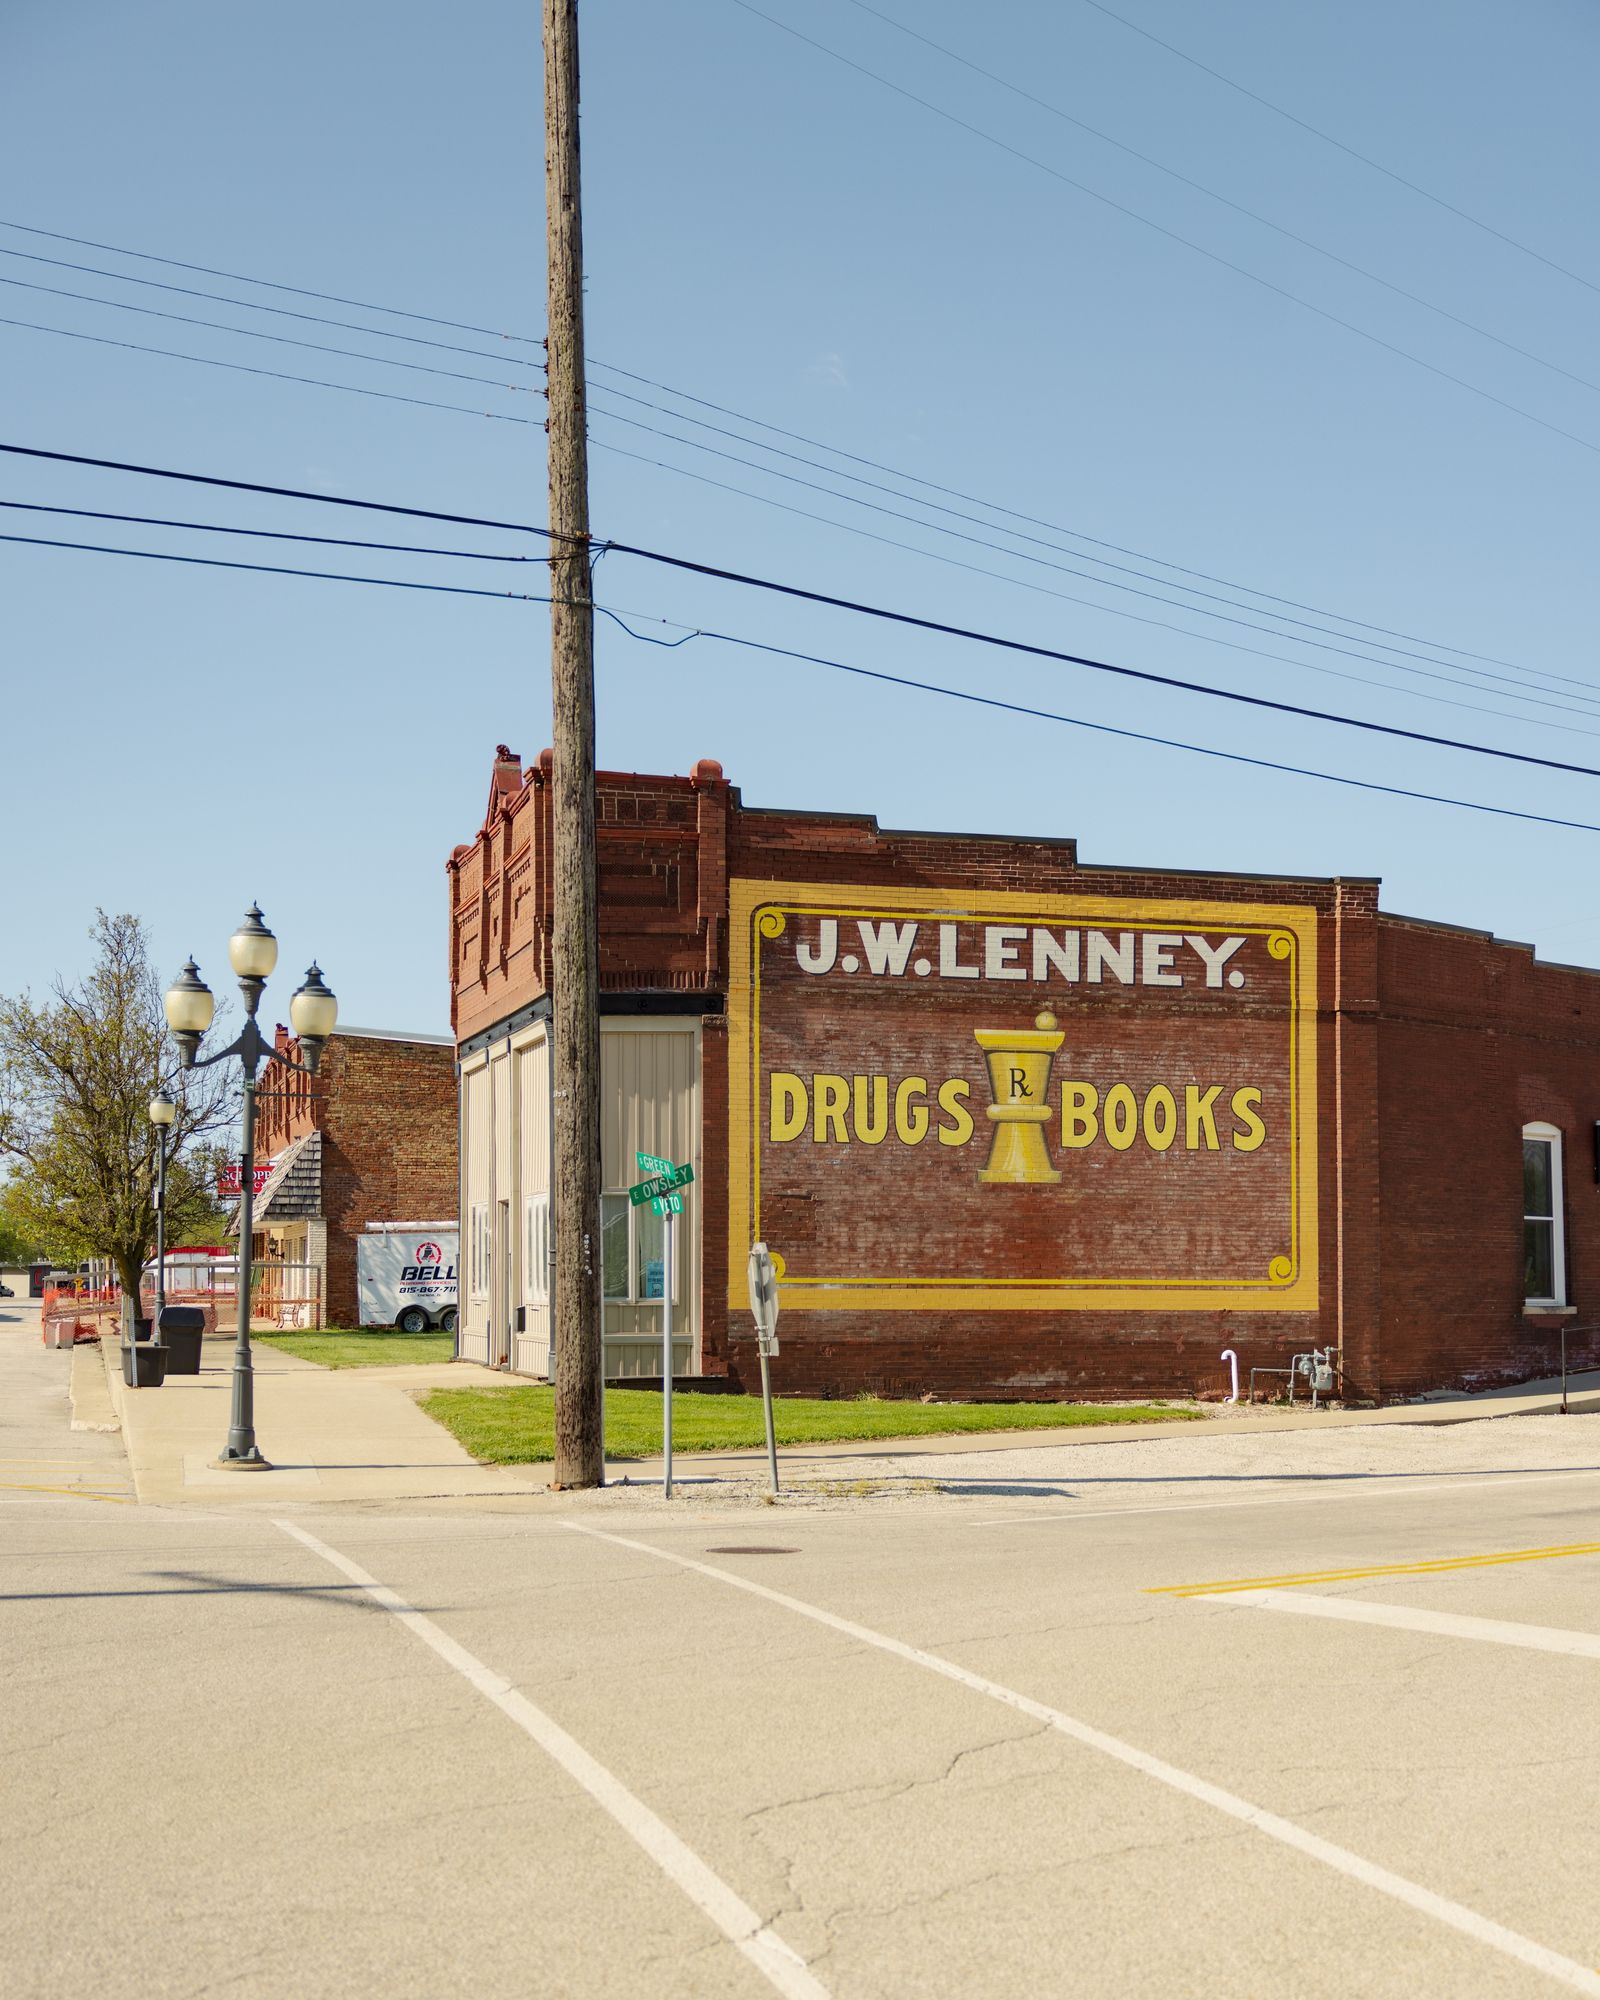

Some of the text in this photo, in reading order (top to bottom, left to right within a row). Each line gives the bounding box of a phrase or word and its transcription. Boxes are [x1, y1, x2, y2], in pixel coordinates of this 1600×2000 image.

[769, 1072, 1267, 1152] DRUGS BOOKS
[643, 1156, 671, 1177] GREEN
[633, 1167, 688, 1199] E OWSLEY
[658, 1196, 680, 1212] VETO
[401, 1266, 457, 1280] BELL
